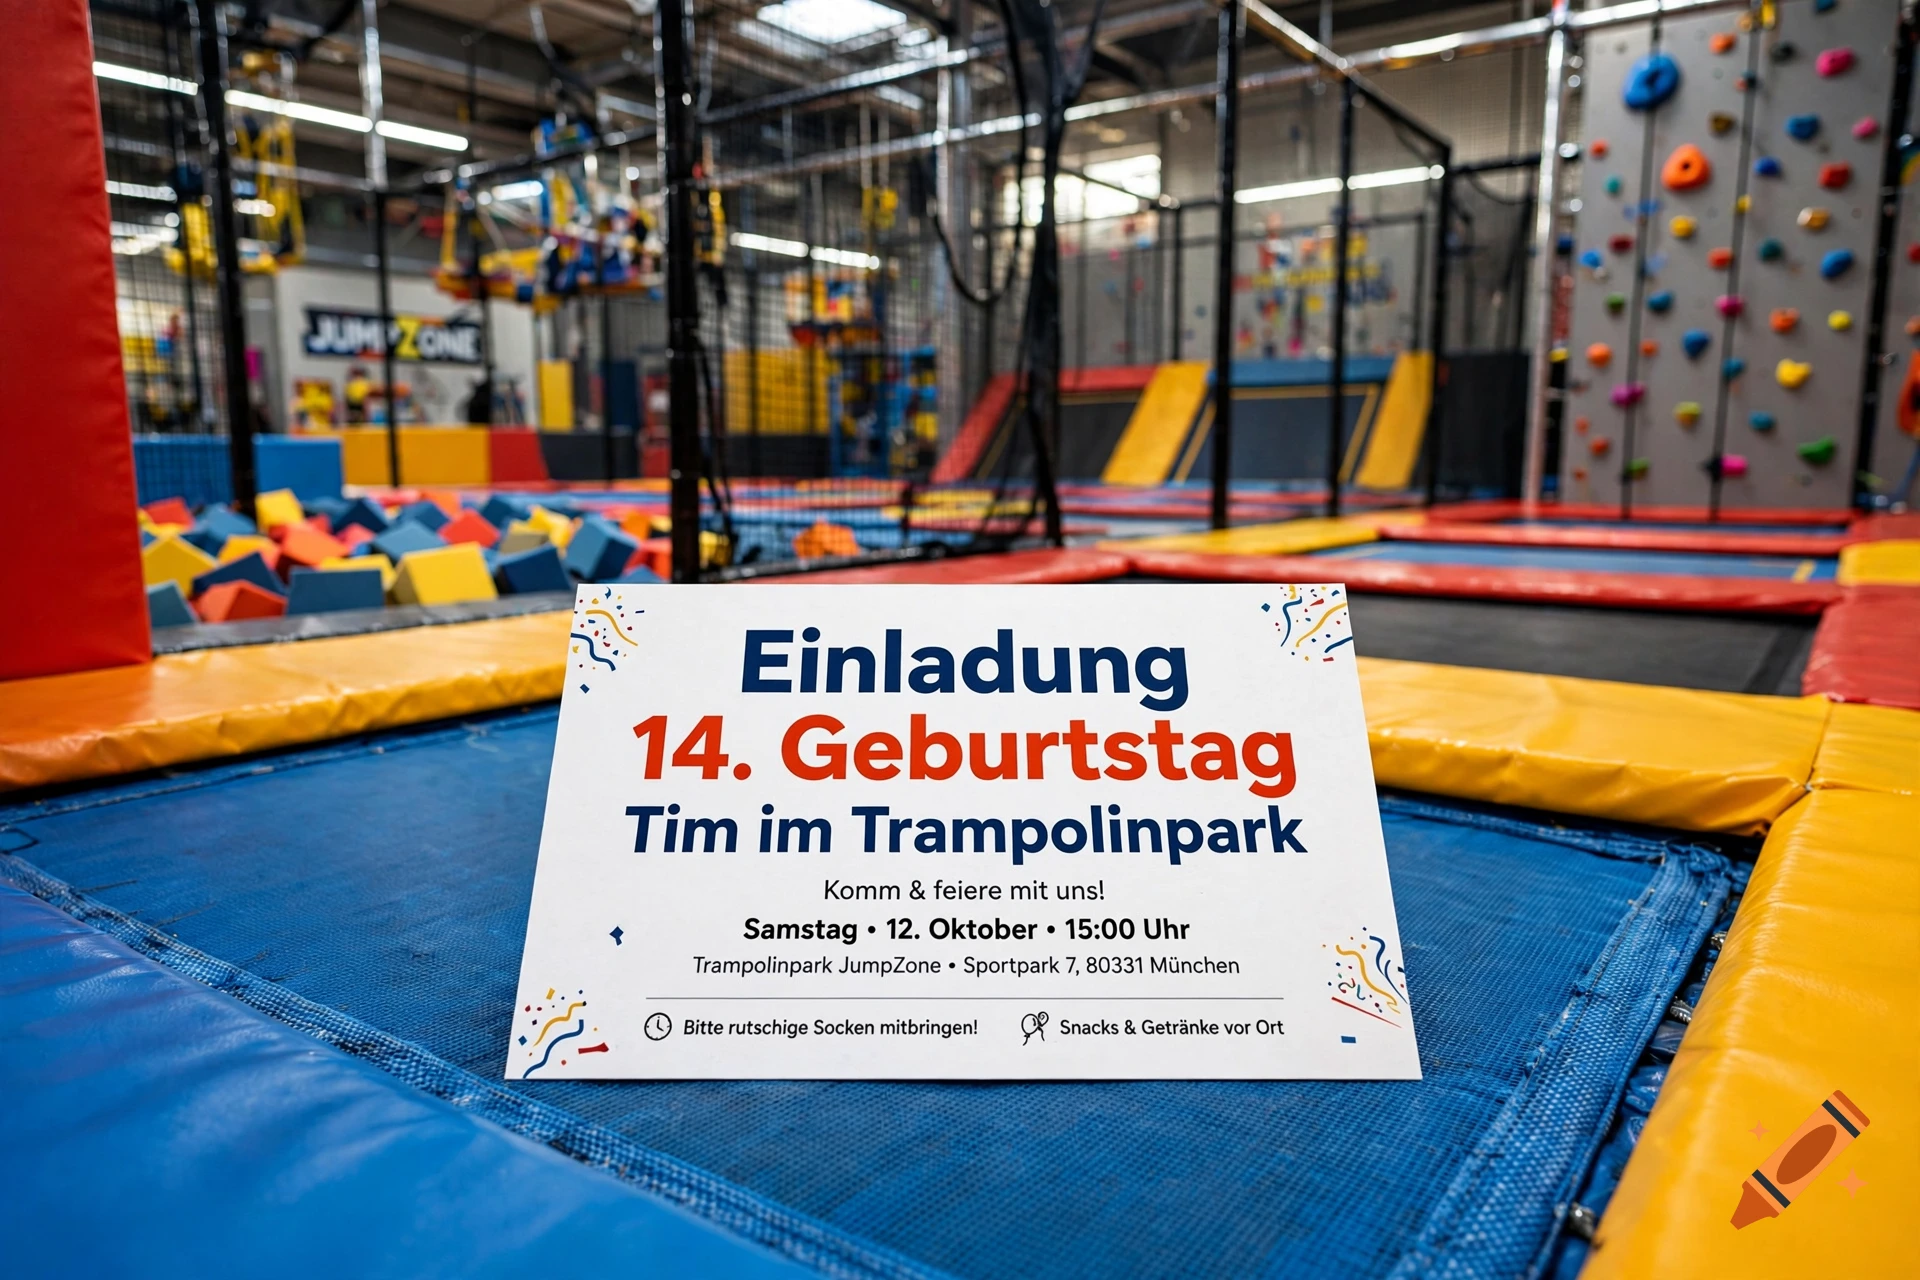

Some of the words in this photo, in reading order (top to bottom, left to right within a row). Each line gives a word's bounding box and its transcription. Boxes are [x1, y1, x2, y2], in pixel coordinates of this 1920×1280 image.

[742, 627, 1189, 711] Einladung
[633, 715, 751, 781] 14.
[781, 714, 1296, 798] Geburtstag
[625, 803, 738, 853] Tim
[759, 804, 831, 853] im
[851, 804, 1308, 865] Trampolinpark
[824, 880, 900, 900] Komm
[909, 880, 926, 900] &
[933, 879, 1002, 900] feiere
[1011, 880, 1048, 900] mit
[1057, 880, 1104, 900] uns!
[743, 918, 857, 945] Samstag
[887, 918, 920, 940] 12.
[929, 918, 1038, 940] Oktober
[1065, 918, 1135, 940] 15:00
[1144, 918, 1190, 940] Uhr
[693, 956, 832, 977] Trampolinpark
[839, 956, 941, 977] JumpZone
[964, 956, 1060, 978] Sportpark
[1066, 957, 1079, 977] 7,
[1087, 957, 1142, 974] 80331
[1150, 955, 1239, 974] München
[684, 1019, 724, 1035] Bitte
[729, 1019, 808, 1039] rutschige
[814, 1019, 874, 1035] Socken
[880, 1019, 977, 1039] mitbringen!
[1060, 1019, 1119, 1036] Snacks
[1124, 1019, 1136, 1036] &
[1142, 1019, 1219, 1036] Getränke
[1224, 1023, 1251, 1036] vor
[1256, 1019, 1284, 1036] Ort
